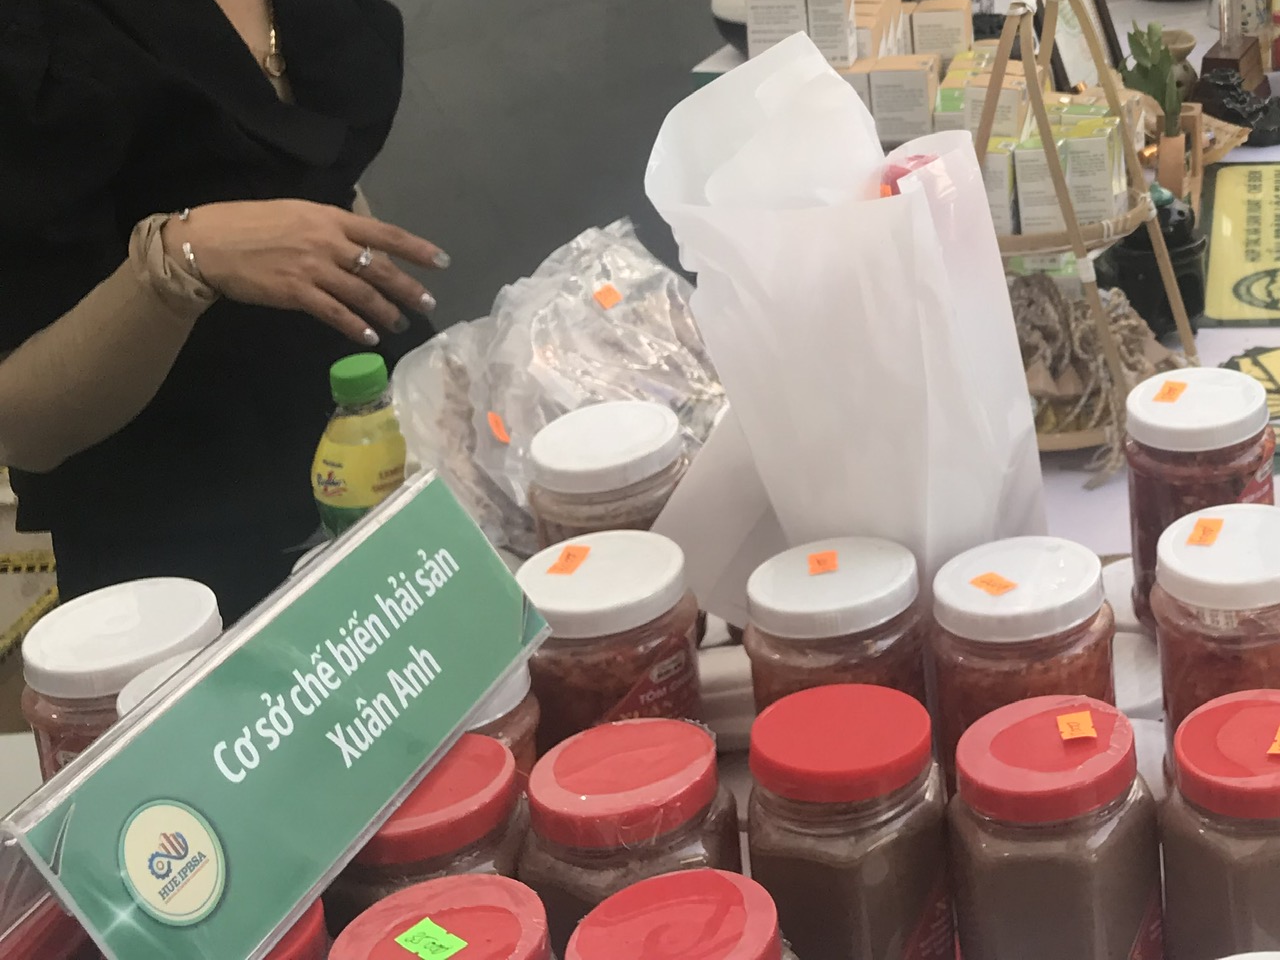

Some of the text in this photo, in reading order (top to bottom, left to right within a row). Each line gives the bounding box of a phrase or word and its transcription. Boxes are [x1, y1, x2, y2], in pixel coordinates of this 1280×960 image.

[213, 548, 460, 783] Cơ sở chế biến hải sản
[325, 645, 442, 769] Xuân Anh
[158, 851, 207, 900] HUE IPBSA
